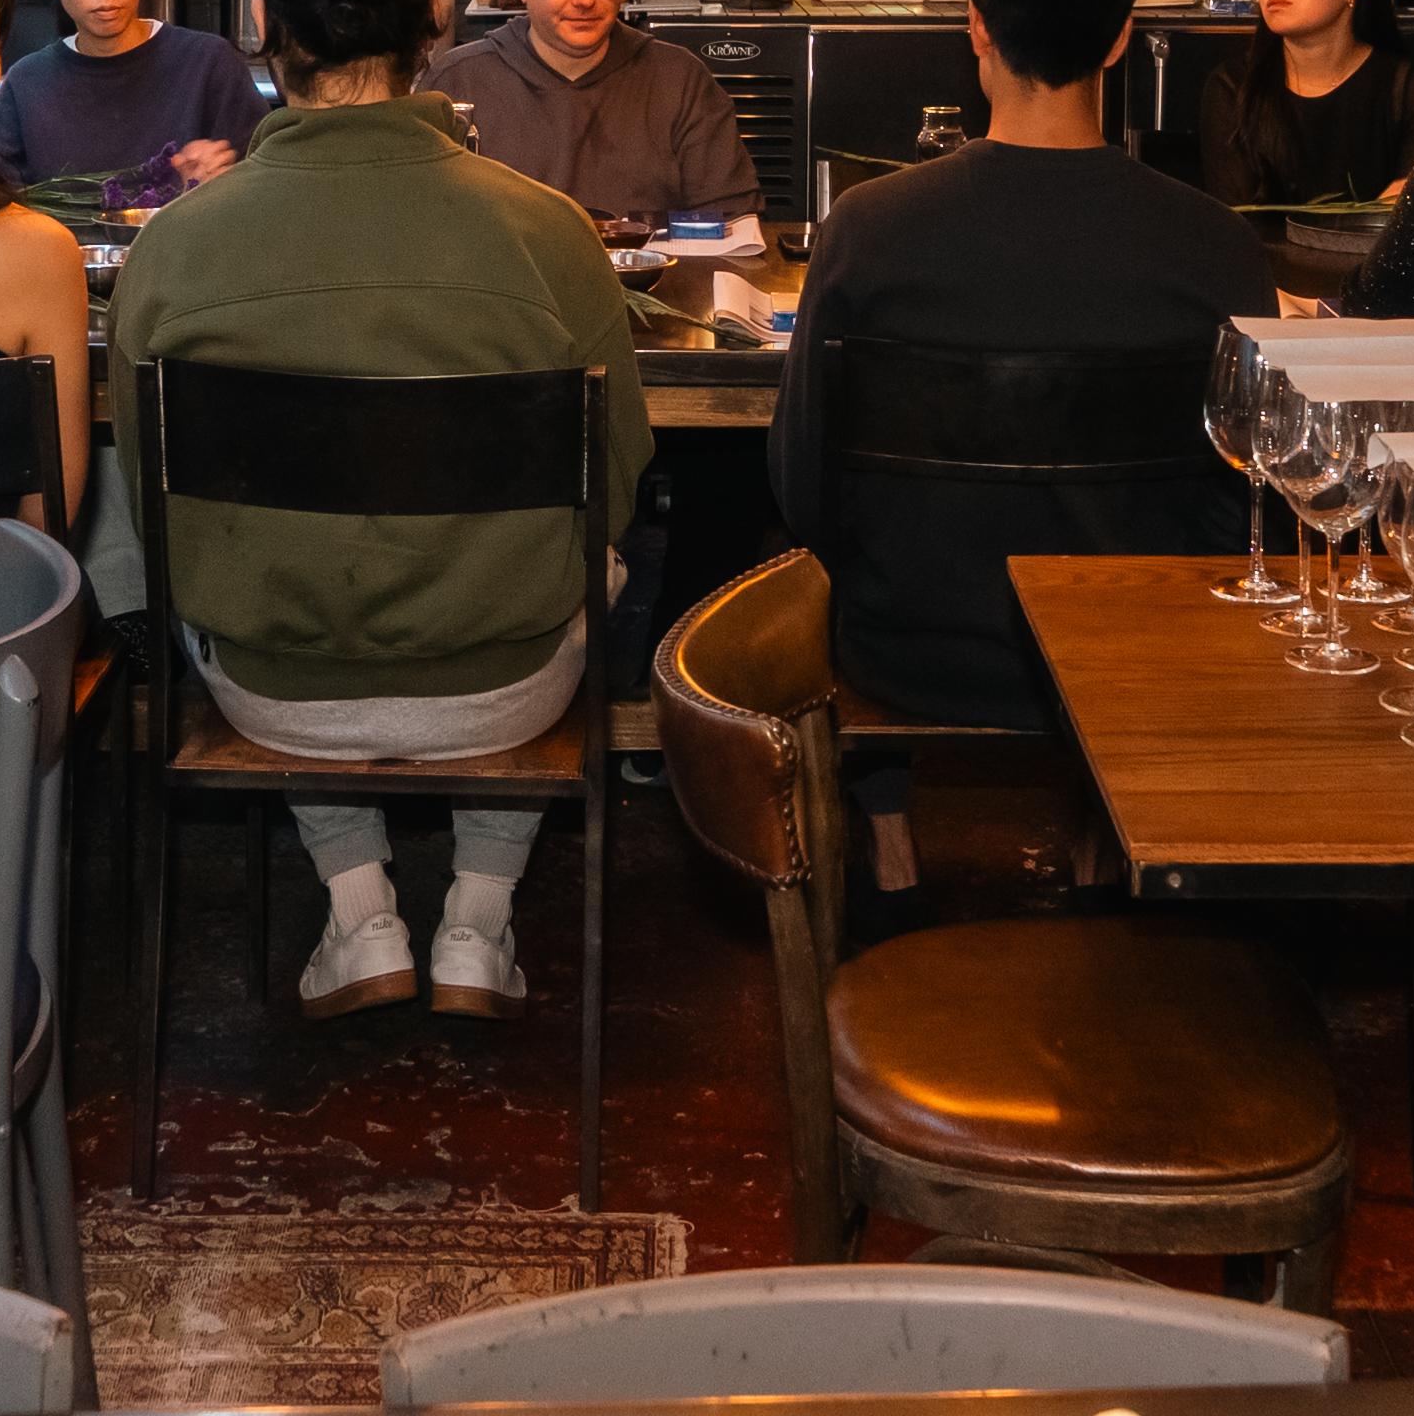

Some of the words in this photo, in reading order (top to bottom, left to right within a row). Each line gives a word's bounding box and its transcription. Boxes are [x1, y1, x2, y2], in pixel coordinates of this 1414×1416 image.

[708, 44, 755, 56] KROWNE
[371, 917, 394, 932] nike
[450, 929, 473, 943] nike
